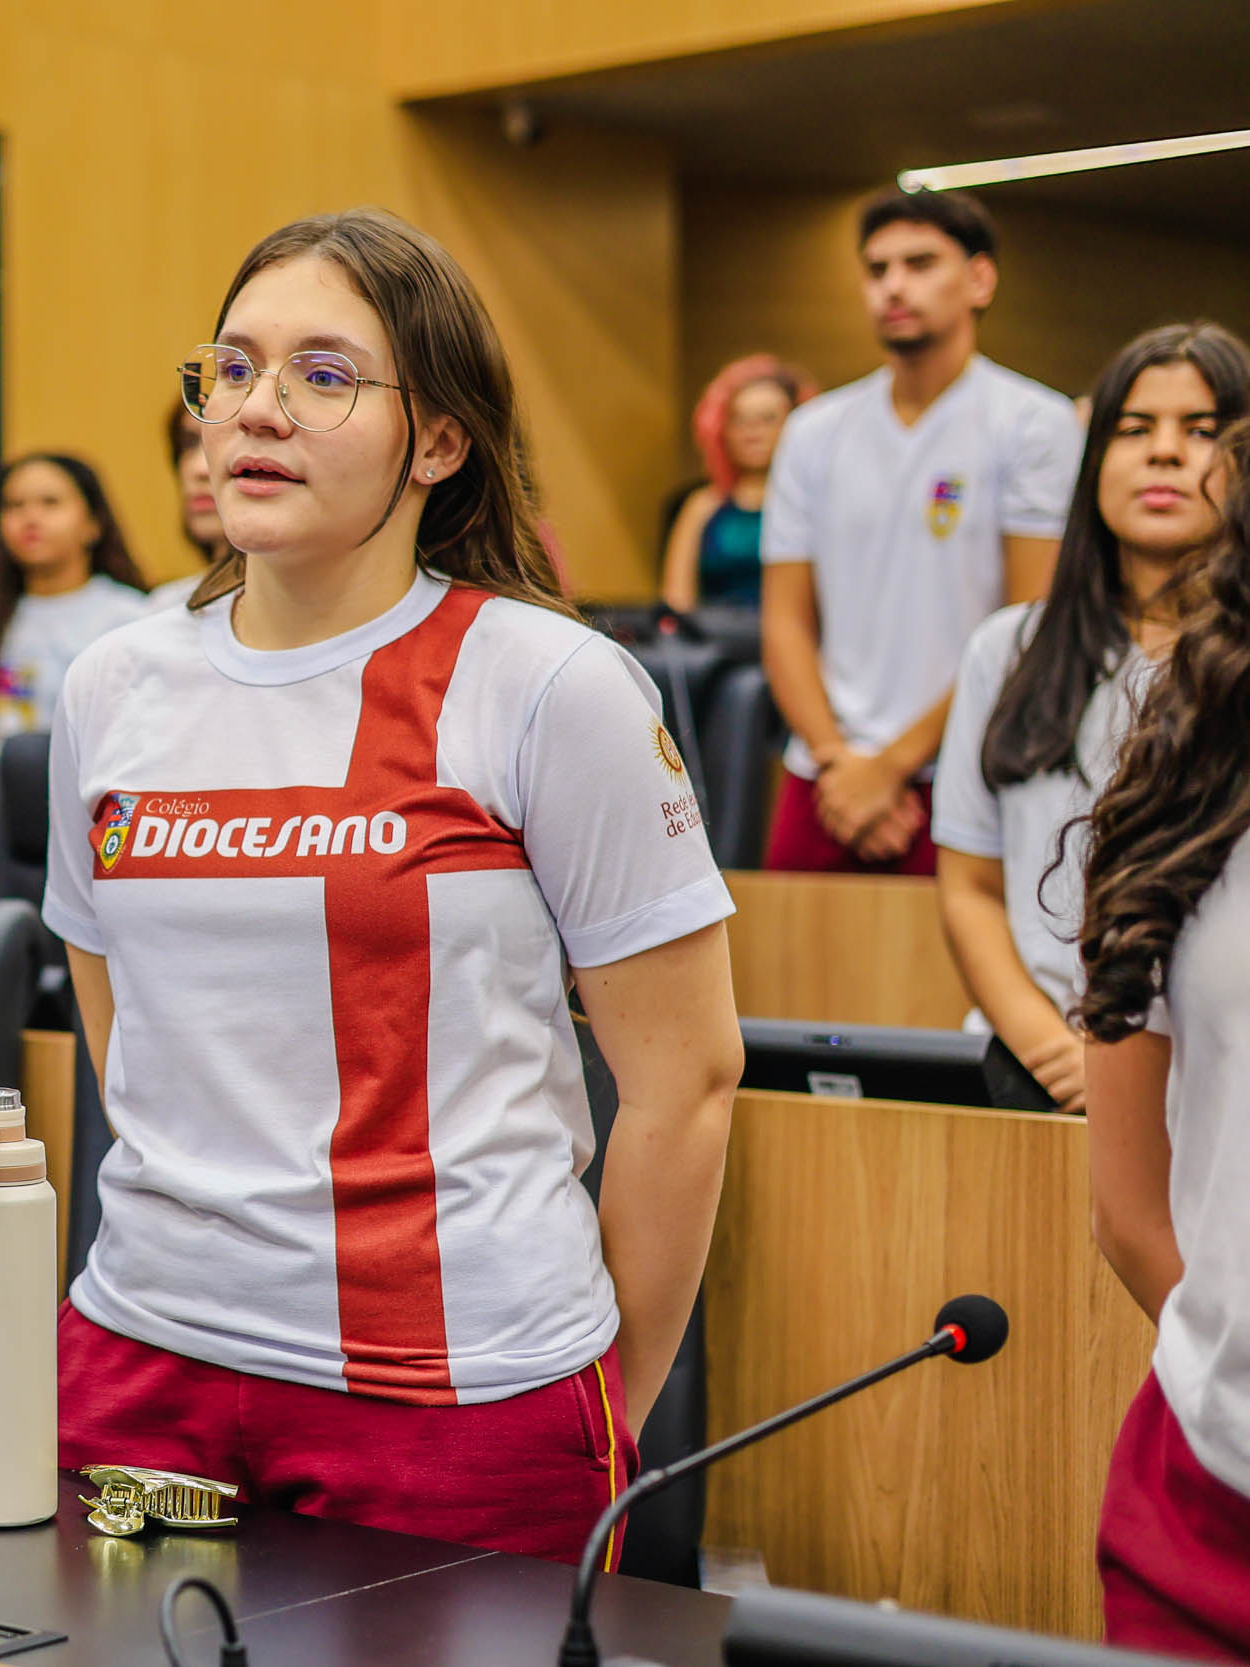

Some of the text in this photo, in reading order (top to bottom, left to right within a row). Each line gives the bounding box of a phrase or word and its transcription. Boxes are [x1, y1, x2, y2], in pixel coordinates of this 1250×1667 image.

[145, 798, 210, 816] Colégio
[131, 811, 407, 858] DIOCESANO
[666, 819, 686, 838] de
